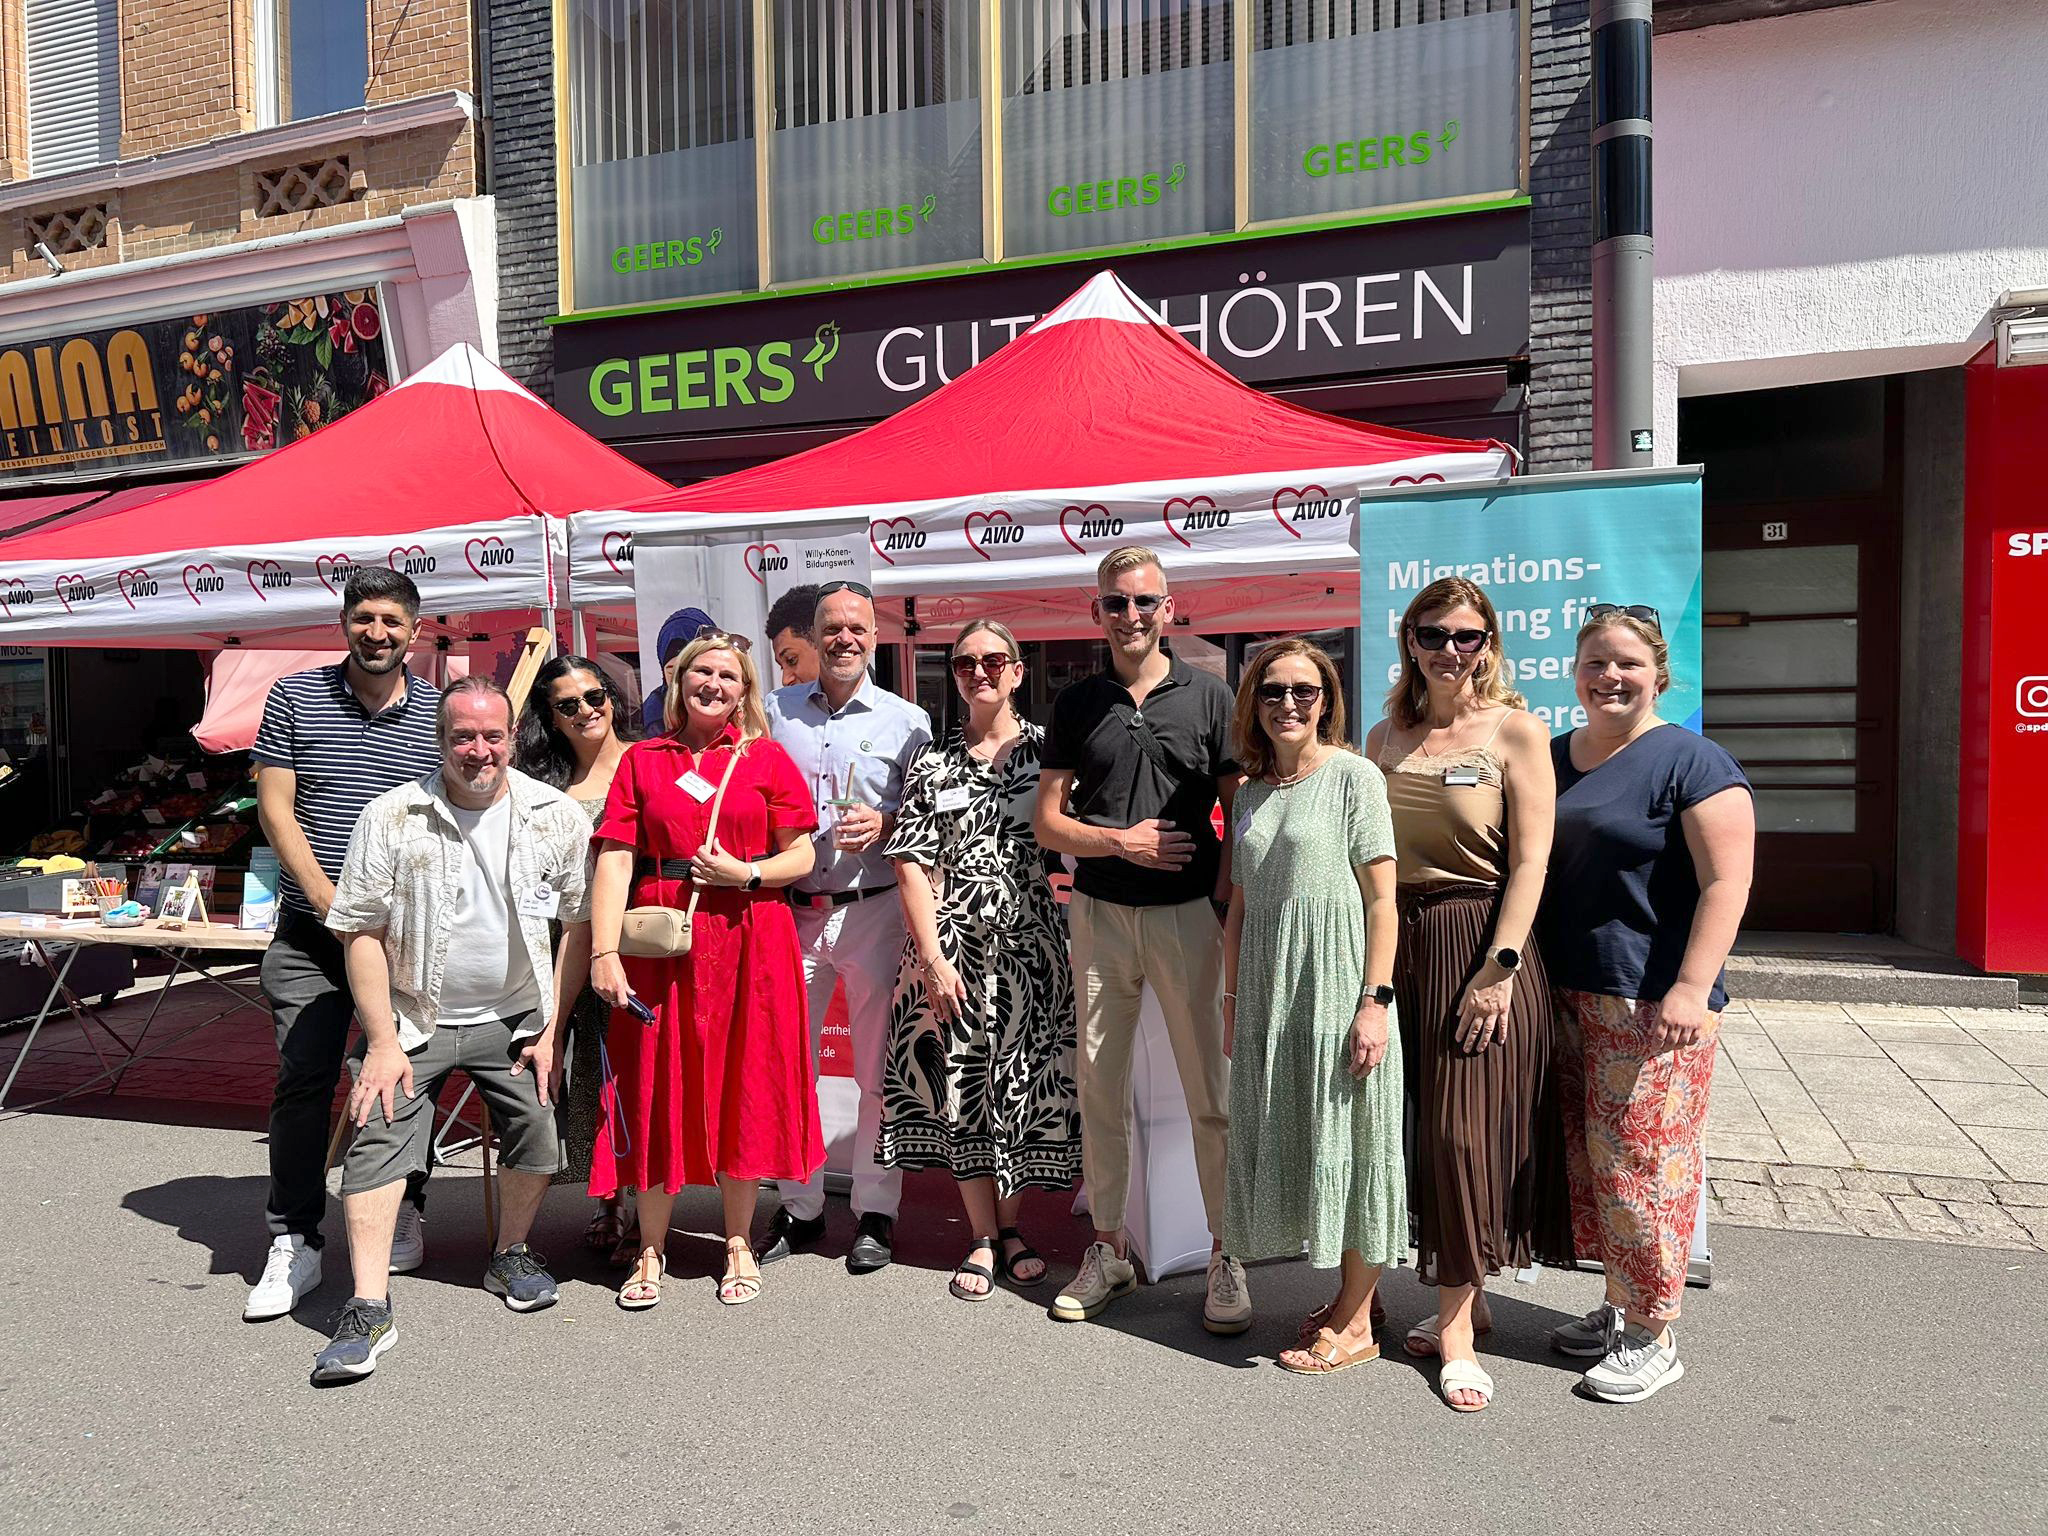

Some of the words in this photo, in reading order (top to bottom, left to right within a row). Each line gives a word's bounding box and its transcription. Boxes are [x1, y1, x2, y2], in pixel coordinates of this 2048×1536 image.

[1303, 131, 1432, 177] GEERS
[1048, 173, 1161, 216] GEERS
[812, 204, 914, 244] GEERS
[611, 237, 703, 273] GEERS
[876, 313, 1050, 392] GUT
[1160, 265, 1473, 358] HÖREN
[588, 341, 795, 417] GEERS
[1292, 498, 1342, 521] AWO
[1079, 518, 1124, 538] AWO
[1183, 509, 1230, 531] AWO
[884, 531, 927, 550] AWO
[980, 525, 1024, 544] AWO
[1767, 524, 1783, 538] 31
[480, 547, 514, 567] AWO
[805, 548, 852, 559] Willy-Könen-
[404, 556, 436, 576] AWO
[758, 556, 788, 572] AWO
[806, 557, 855, 570] Bildungswerk
[130, 581, 158, 598] AWO
[195, 577, 224, 593] AWO
[262, 571, 292, 589] AWO
[8, 589, 34, 605] AWO
[68, 585, 95, 601] AWO
